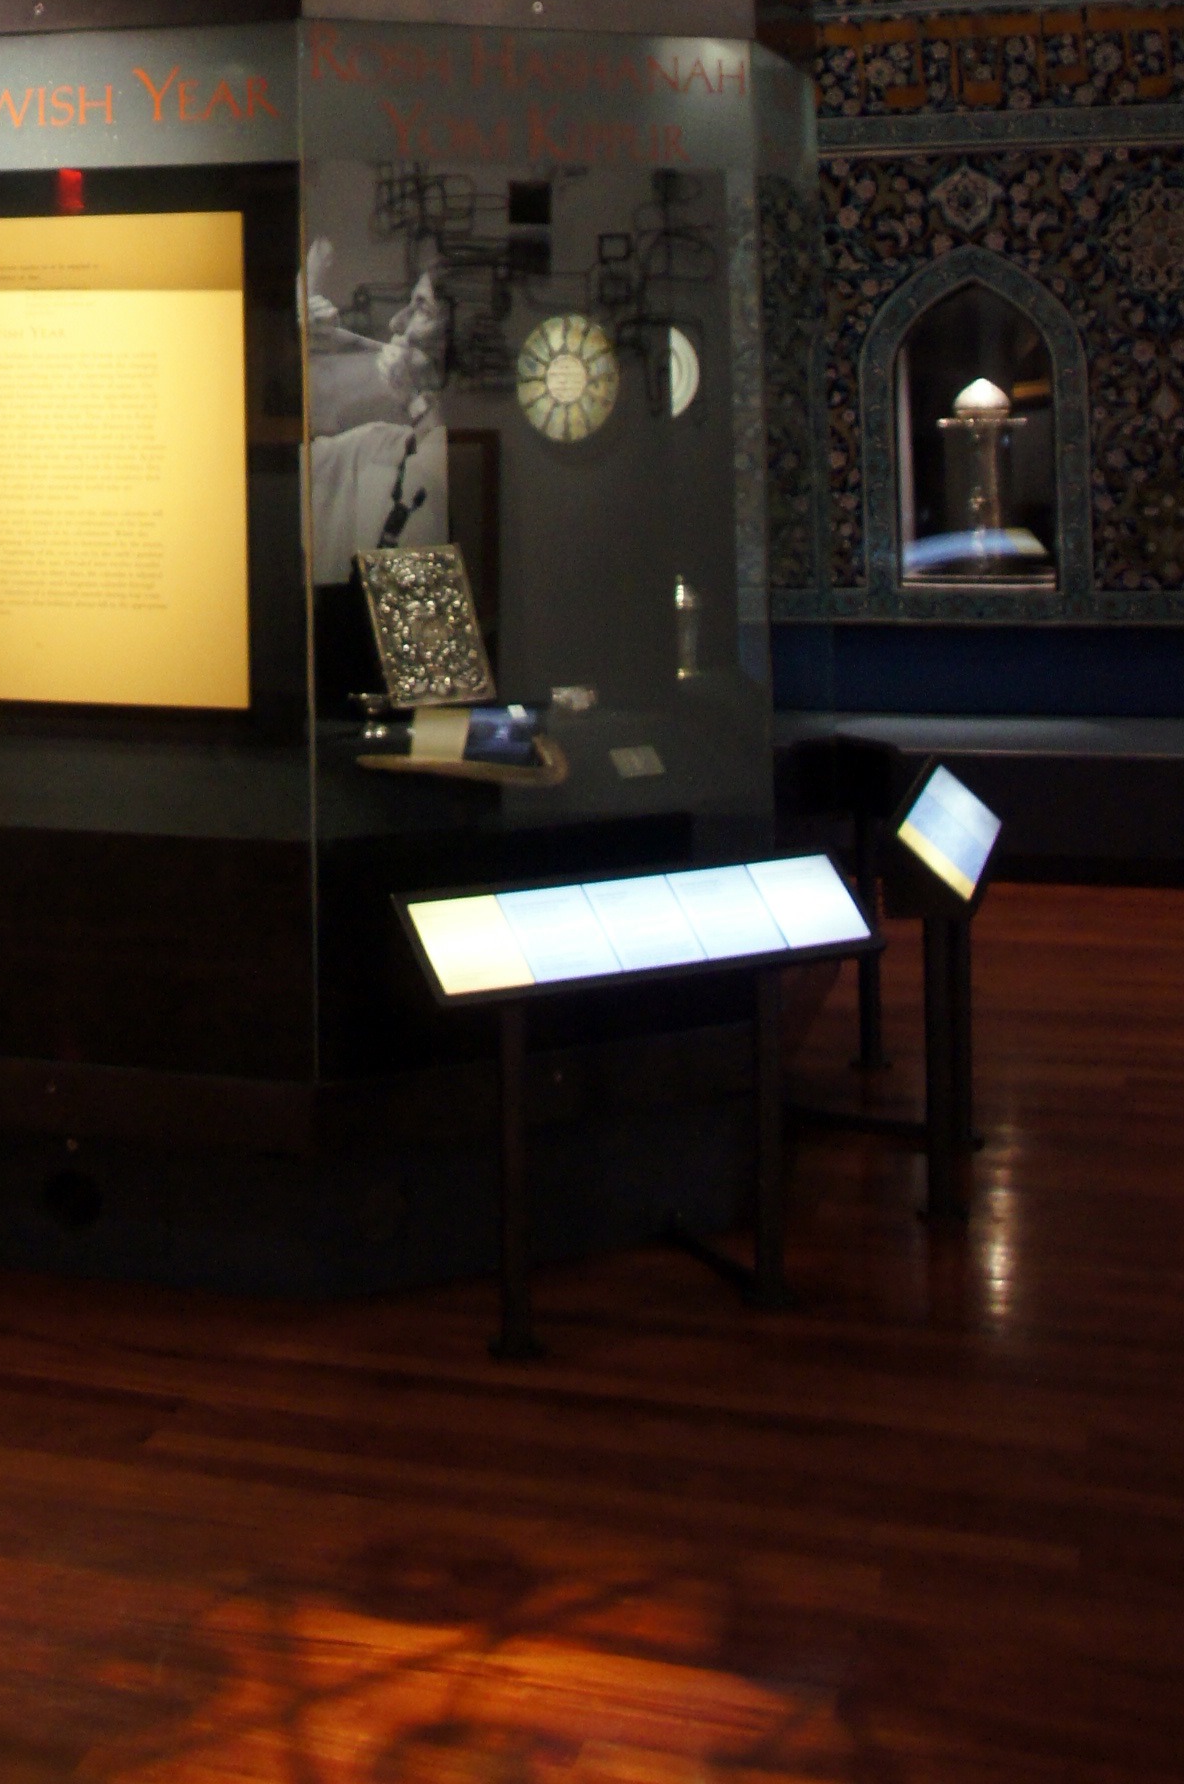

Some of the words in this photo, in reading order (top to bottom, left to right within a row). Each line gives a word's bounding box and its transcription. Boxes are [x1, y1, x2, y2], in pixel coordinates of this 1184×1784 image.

[305, 22, 453, 88] ROSH
[469, 33, 748, 97] HASHANAH
[131, 65, 282, 123] YEAR
[381, 99, 512, 160] YOM
[527, 101, 691, 164] KIPPUR
